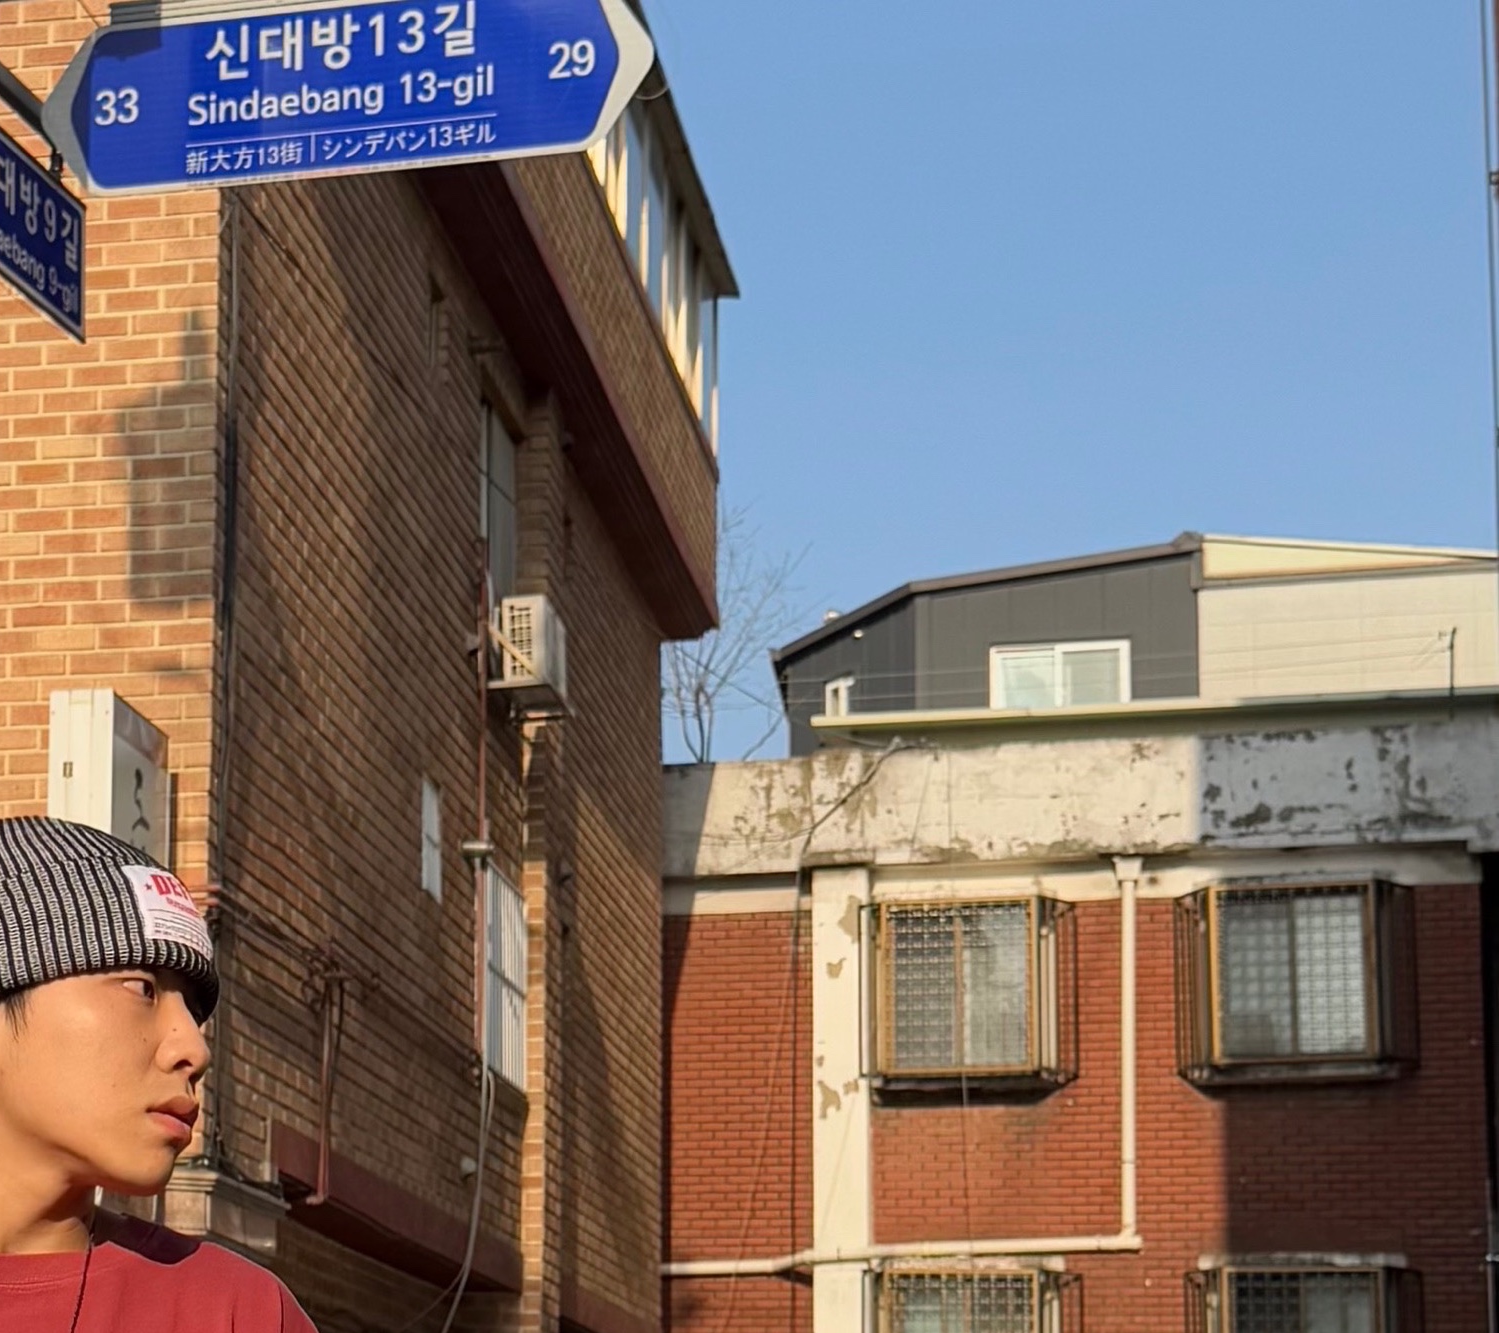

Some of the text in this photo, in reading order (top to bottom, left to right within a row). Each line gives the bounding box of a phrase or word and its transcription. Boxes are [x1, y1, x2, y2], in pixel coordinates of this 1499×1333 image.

[204, 0, 476, 81] 신대방13길
[548, 39, 596, 79] 29
[94, 87, 140, 126] 33
[187, 63, 494, 127] Sindaebang 13-gil
[185, 141, 303, 175] 新大方13街
